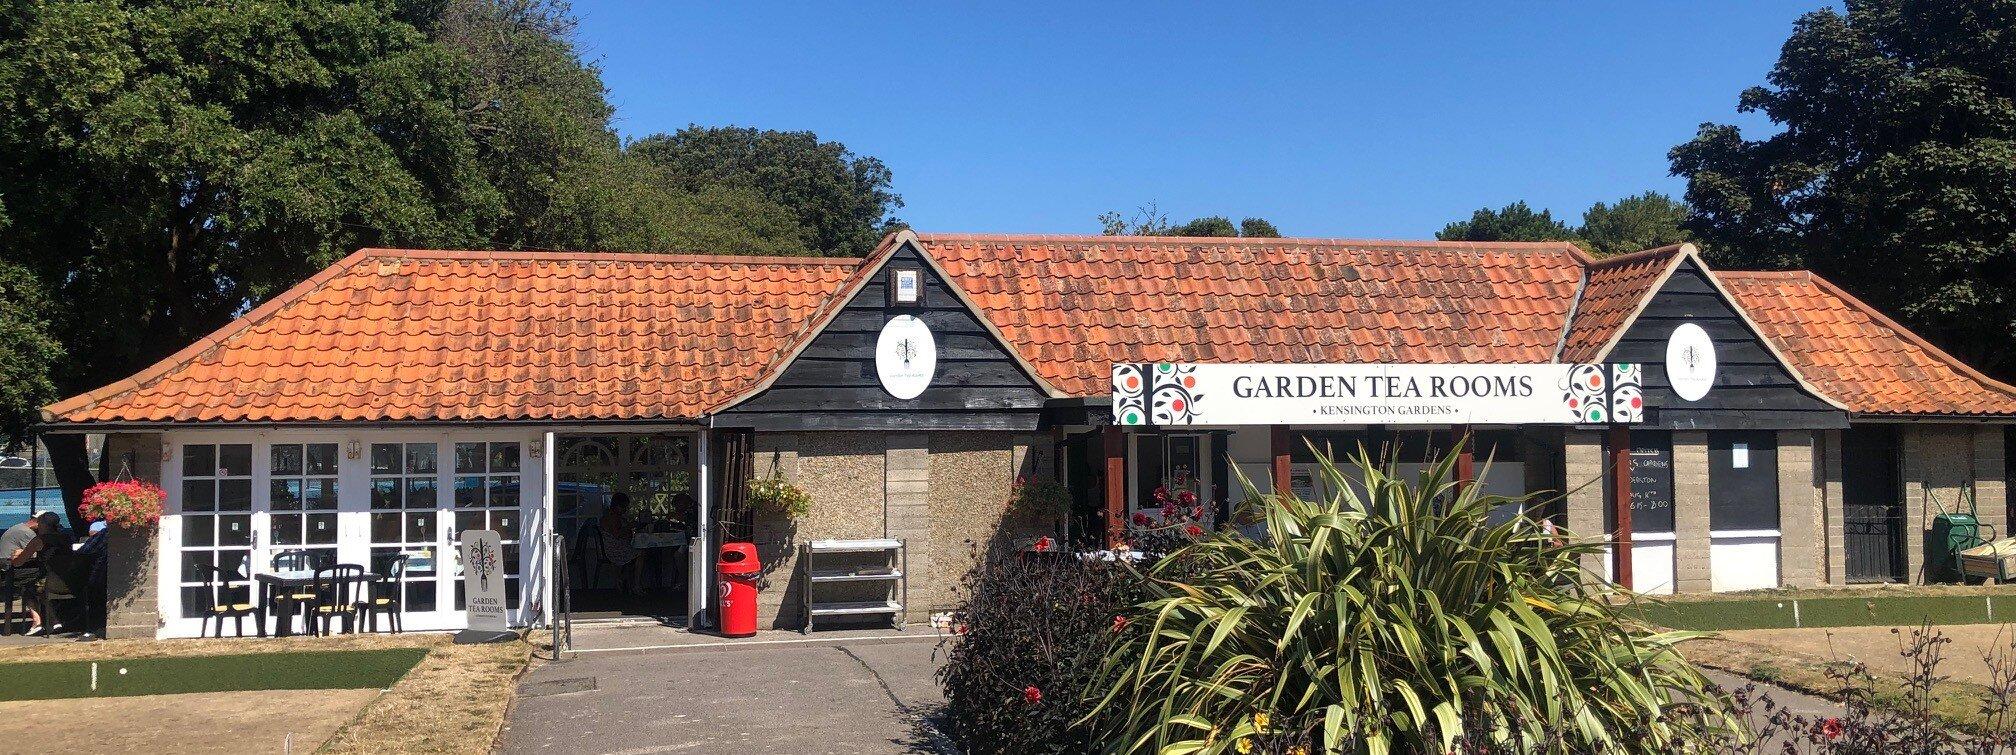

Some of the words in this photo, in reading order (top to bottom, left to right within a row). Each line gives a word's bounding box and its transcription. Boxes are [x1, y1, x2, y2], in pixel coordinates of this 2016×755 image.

[1233, 375, 1356, 398] GARDEN
[1364, 375, 1423, 398] TEA
[1430, 375, 1533, 398] ROOMS
[1320, 405, 1396, 416] KENSINGTON
[1398, 405, 1452, 416] GARDENS
[473, 597, 498, 605] GARDEN
[469, 605, 480, 613] TEA
[481, 605, 503, 613] ROOMS
